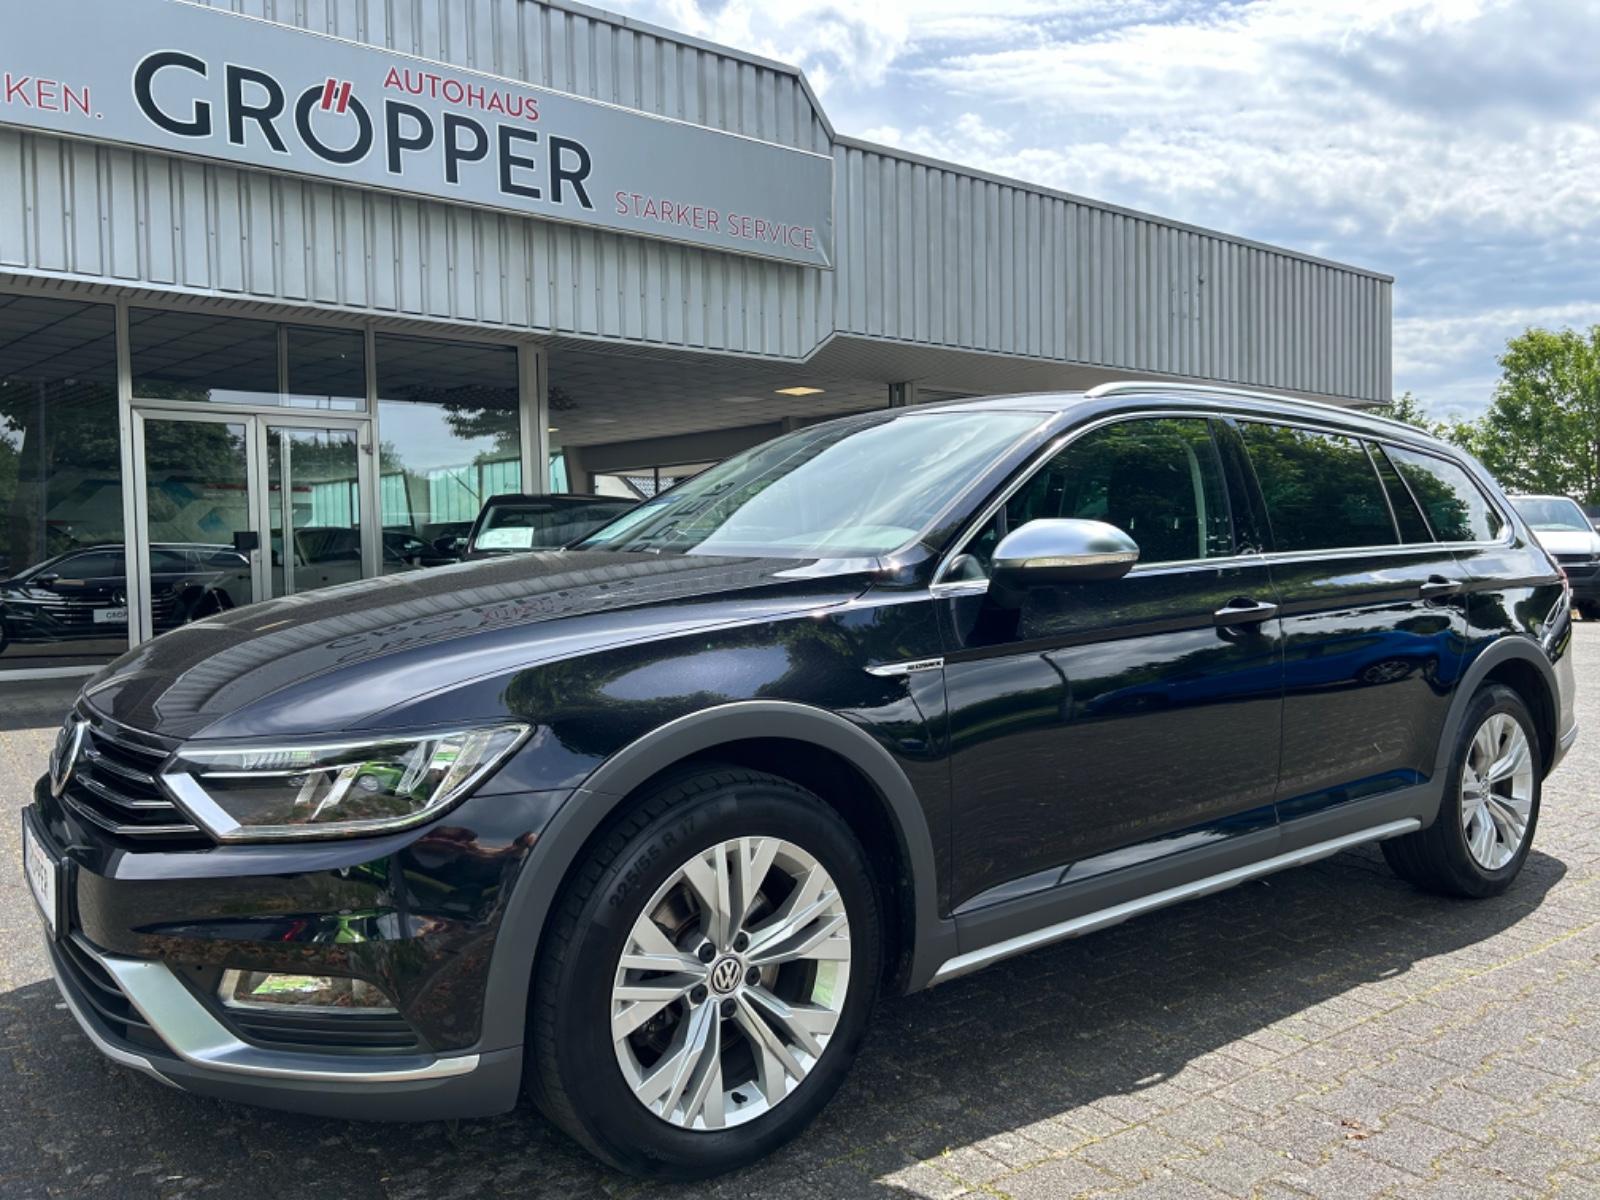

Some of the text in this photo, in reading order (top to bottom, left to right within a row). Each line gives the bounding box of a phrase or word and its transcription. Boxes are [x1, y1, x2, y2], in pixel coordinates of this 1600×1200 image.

[384, 66, 540, 122] AUTOHAUS
[133, 50, 594, 210] GRÖPPER
[614, 190, 816, 250] STARKER SERVICE
[664, 831, 677, 847] R
